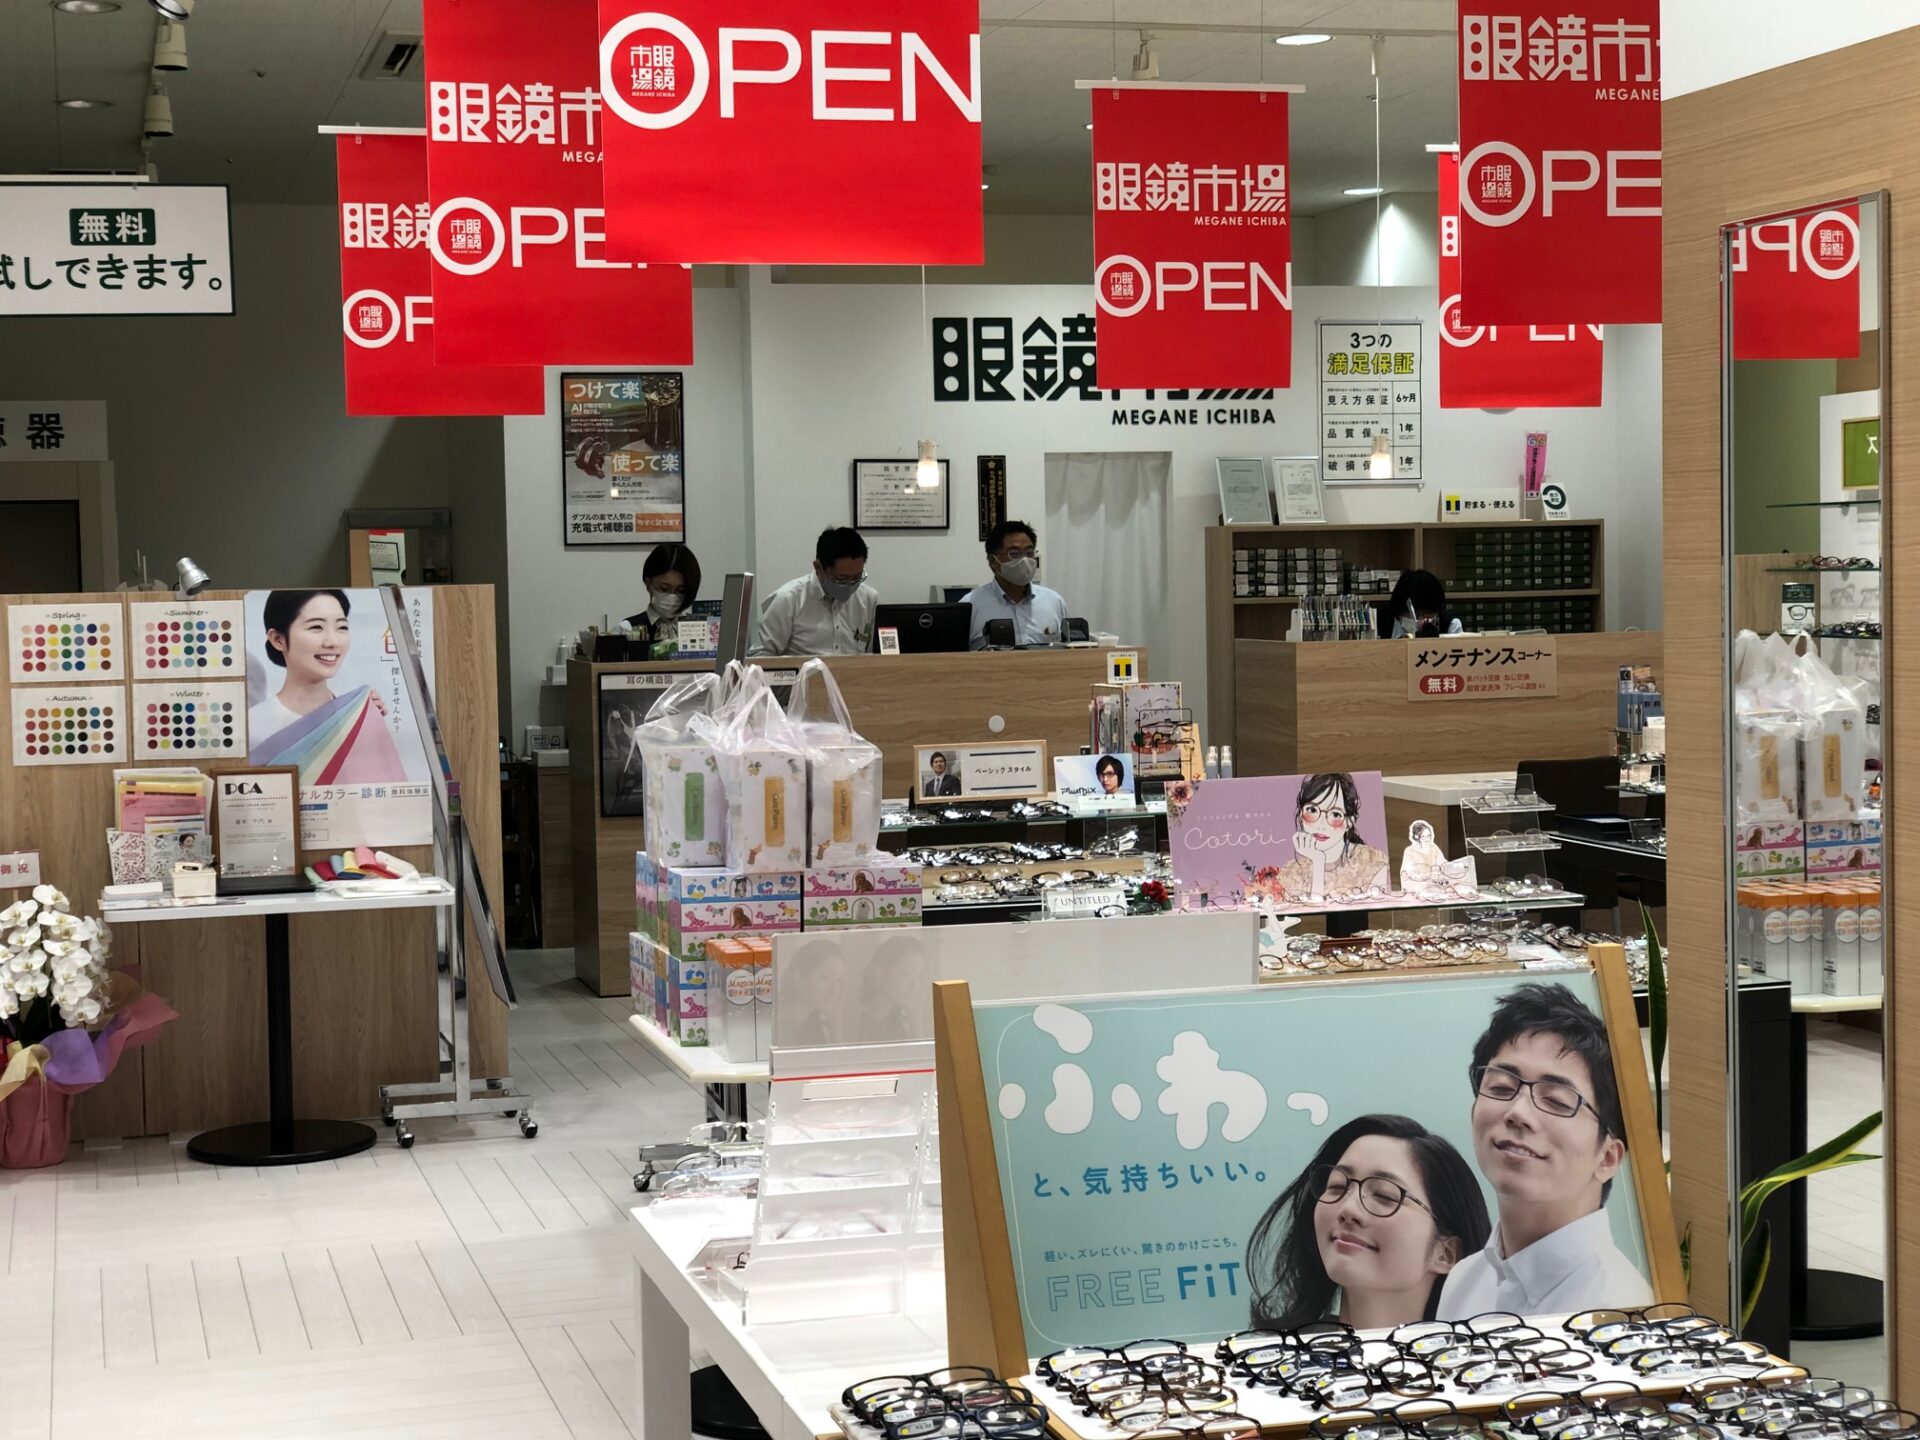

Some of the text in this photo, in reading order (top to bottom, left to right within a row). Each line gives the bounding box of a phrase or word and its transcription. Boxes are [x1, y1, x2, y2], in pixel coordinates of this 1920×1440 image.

[1463, 14, 1661, 82] 眼鏡市
[599, 11, 982, 129] OPEN
[1595, 88, 1660, 101] MEGANE
[1096, 161, 1287, 213] 眼鏡市場
[78, 211, 148, 243] 無料
[1194, 216, 1287, 227] MEGANE ICHIBA
[430, 197, 693, 276] OPE
[1094, 254, 1293, 318] OPEN
[1350, 332, 1392, 349] 3つの
[1327, 352, 1415, 375] 満足保証
[570, 382, 640, 400] つけて楽
[1327, 395, 1389, 406] 見え方保証
[1112, 409, 1276, 425] MEGANE ICHIBA
[0, 413, 65, 450] 器
[1399, 423, 1414, 433] 1年
[612, 453, 680, 472] 使って楽
[1399, 456, 1414, 466] 1年
[571, 522, 634, 533] 充電式補聴器
[51, 612, 81, 620] Spring
[169, 609, 205, 618] Summer
[626, 675, 674, 685] 耳の構造図
[1427, 676, 1458, 693] 無料
[52, 694, 88, 702] Autumn
[176, 690, 204, 699] Winter
[225, 782, 263, 796] PCA
[1060, 895, 1111, 906] UNTITLED
[998, 1003, 1330, 1151] ふわっ
[1033, 1161, 1267, 1198] と、気持ちいい。
[1047, 1261, 1241, 1312] FREE FiT
